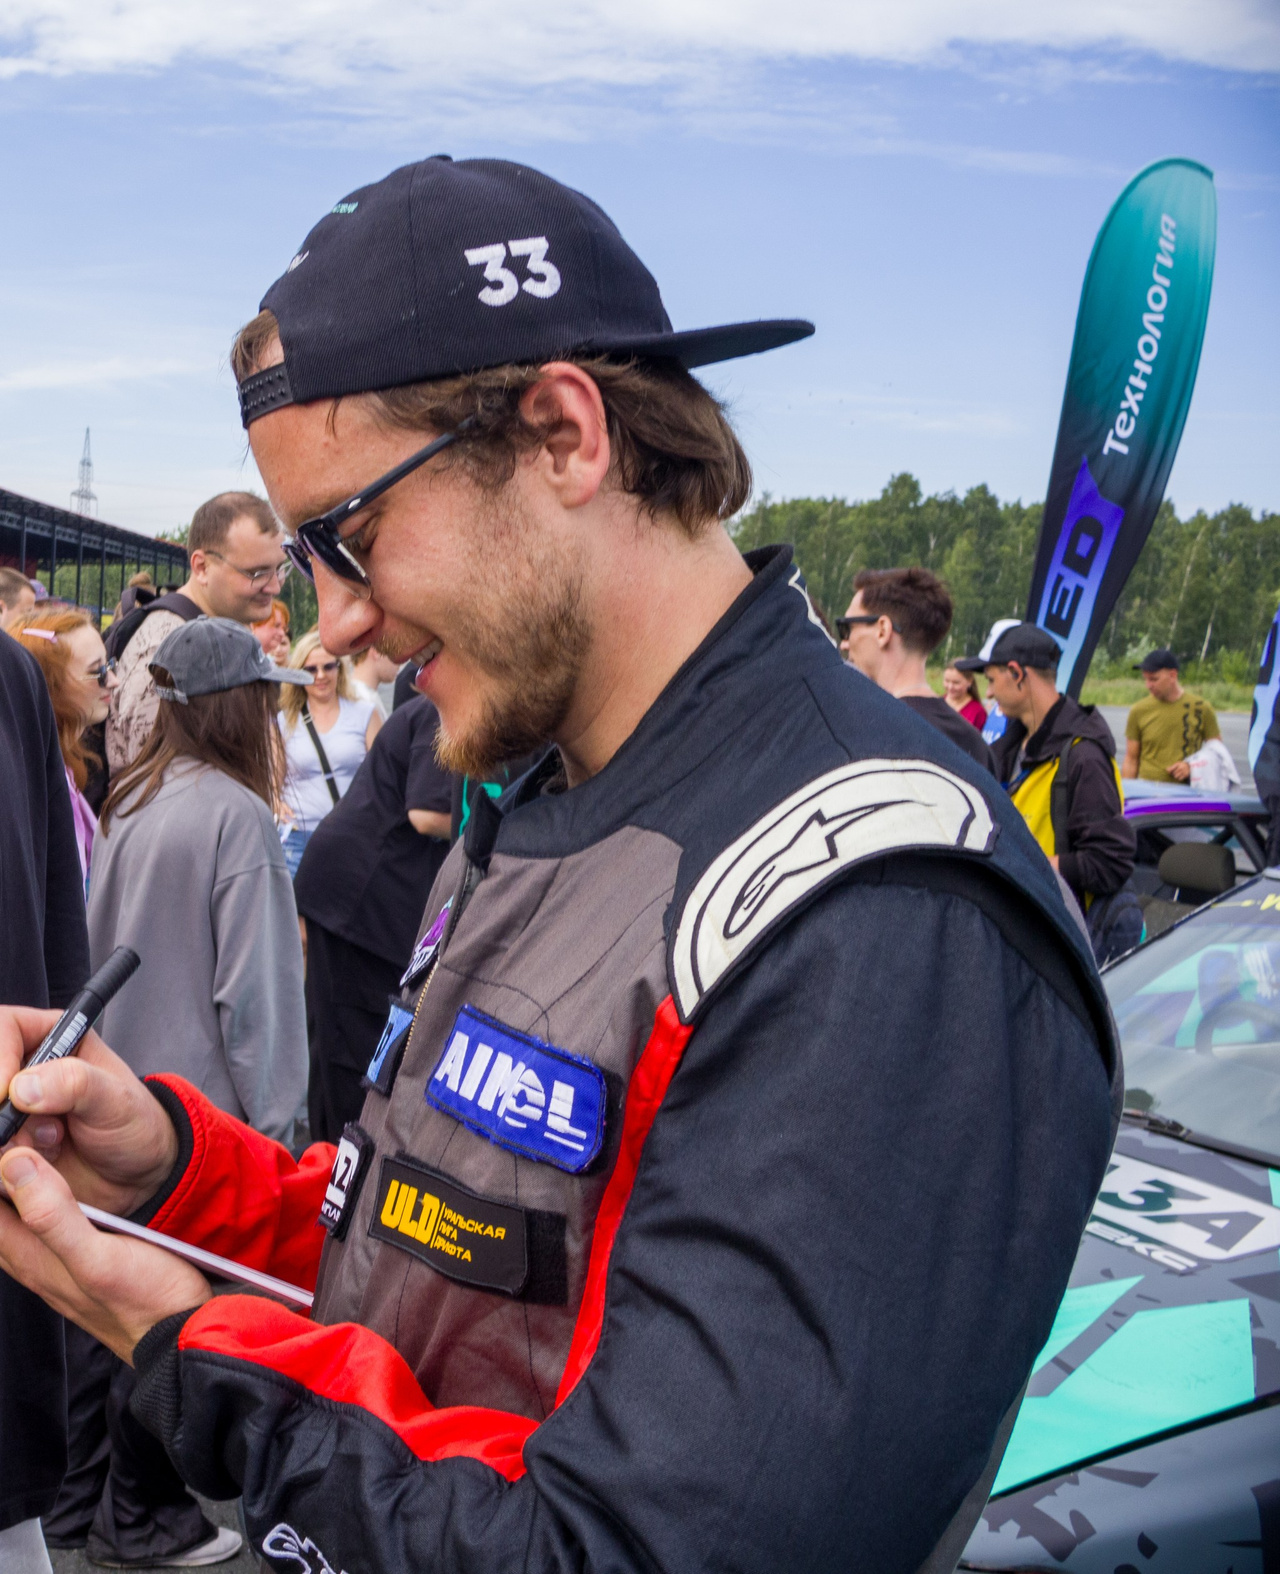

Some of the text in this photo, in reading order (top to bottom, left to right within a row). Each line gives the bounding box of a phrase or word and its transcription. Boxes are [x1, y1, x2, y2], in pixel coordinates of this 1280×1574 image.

[463, 236, 562, 307] 33
[1103, 212, 1177, 456] Технология
[380, 1178, 440, 1245] ULD
[439, 1223, 458, 1242] ЛИГА
[443, 1207, 507, 1240] УРАЛЬСКАЯ
[1098, 1164, 1266, 1252] 3A
[434, 1235, 472, 1262] ДРИФТА
